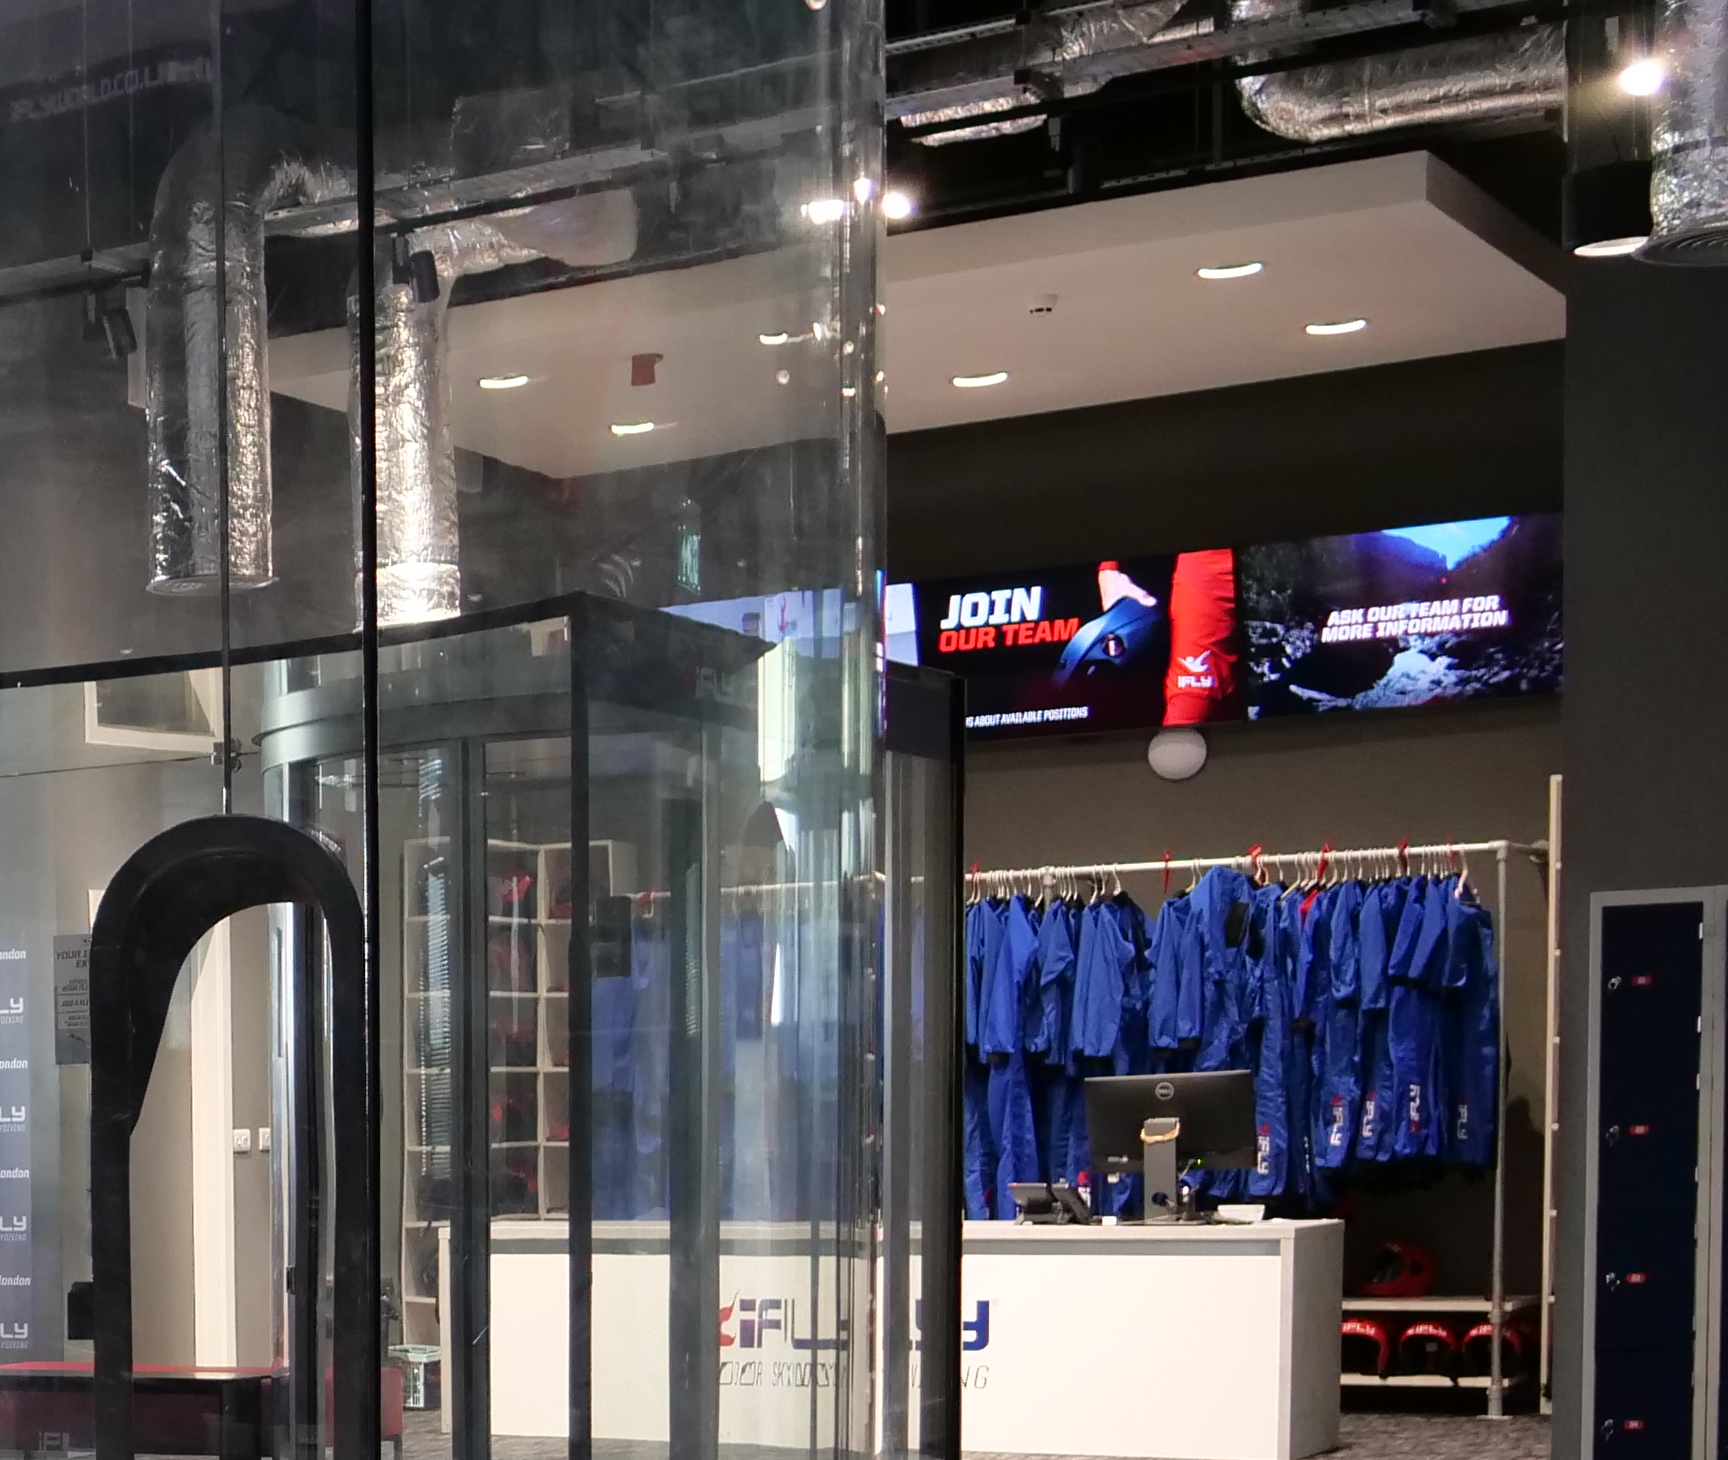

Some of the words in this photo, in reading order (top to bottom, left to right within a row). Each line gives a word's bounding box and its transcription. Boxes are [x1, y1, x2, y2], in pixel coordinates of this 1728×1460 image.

[940, 586, 1042, 630] JOIN
[1327, 608, 1364, 626] ASK
[1367, 604, 1406, 622] OUR
[1408, 599, 1460, 618] TEAM
[1462, 595, 1501, 613] FOR
[939, 624, 995, 652] OUR
[1012, 618, 1082, 646] TEAM
[1321, 623, 1374, 642] MORE
[1376, 610, 1509, 637] INFORMATION
[1043, 706, 1089, 722] POSITIONS
[1257, 1135, 1270, 1175] iFLY
